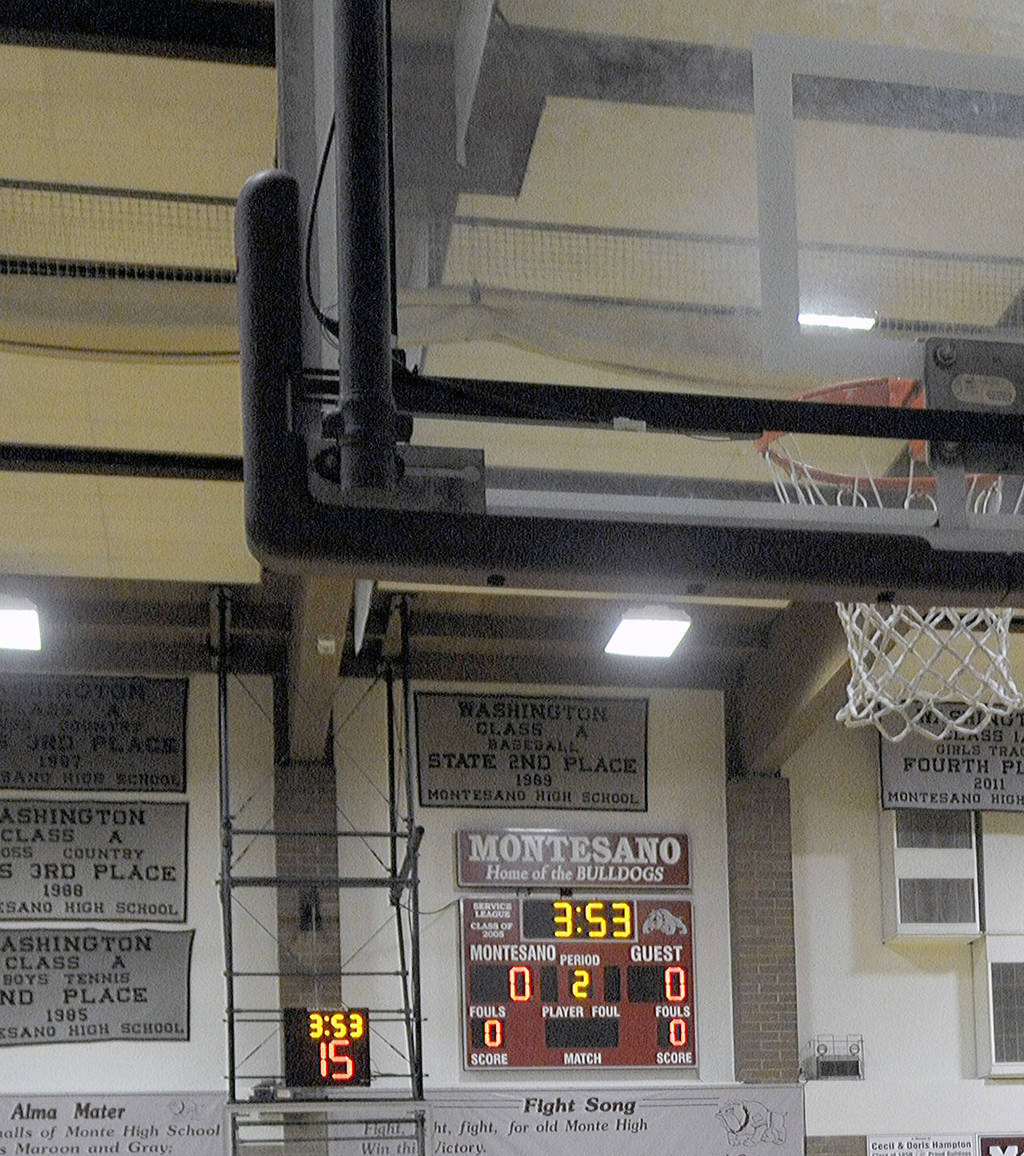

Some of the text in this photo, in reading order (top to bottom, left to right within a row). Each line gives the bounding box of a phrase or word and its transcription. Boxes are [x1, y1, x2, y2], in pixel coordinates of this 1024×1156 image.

[936, 745, 983, 757] GIRLS
[428, 753, 638, 774] STATE 2ND PLACE
[903, 758, 989, 775] FOURTH
[973, 777, 1006, 791] 2011
[428, 788, 526, 802] MONTESANO
[582, 792, 640, 805] SCHOOL
[887, 791, 981, 805] MONTESANO
[1, 829, 75, 843] CLASS
[469, 834, 681, 865] MONTESANO
[30, 863, 176, 882] 3RD PLACE
[486, 865, 664, 881] Home of the BULLDOGS
[44, 884, 84, 898] 1988
[65, 902, 178, 916] HIGH SCHOOL
[473, 902, 512, 911] SERVICE
[475, 911, 511, 919] LEAGUE
[553, 902, 632, 939] 3:53
[501, 922, 513, 931] OF
[470, 945, 556, 961] MONTESANO
[560, 954, 600, 966] PERIOD
[631, 945, 683, 962] GUEST
[6, 956, 80, 970] CLASS
[3, 973, 130, 986] BOYS TENNIS
[508, 965, 532, 1002] 0
[571, 969, 591, 999] 2
[664, 965, 688, 1002] 0
[63, 987, 148, 1004] PLACE
[47, 1009, 88, 1023] 1985
[469, 1006, 506, 1018] FOULS
[542, 1006, 620, 1018] PLAYER FOUL
[655, 1006, 691, 1018] FOULS
[69, 1023, 184, 1037] HIGH SCHOOL
[308, 1012, 364, 1039] 3:53
[668, 1017, 688, 1048] 0
[483, 1018, 503, 1049] 0
[320, 1039, 354, 1080] 15
[471, 1053, 508, 1065] SCORE
[564, 1052, 602, 1065] MATCH
[656, 1051, 693, 1064] SCORE
[11, 1102, 126, 1121] Alma Mater
[523, 1096, 637, 1117] Fight Song
[40, 1124, 221, 1141] of Monte High School
[458, 1117, 648, 1137] fight, for old Monte High
[16, 1142, 80, 1155] Maroon
[88, 1142, 120, 1154] and
[871, 1140, 972, 1151] Cecil Doris Hampton
